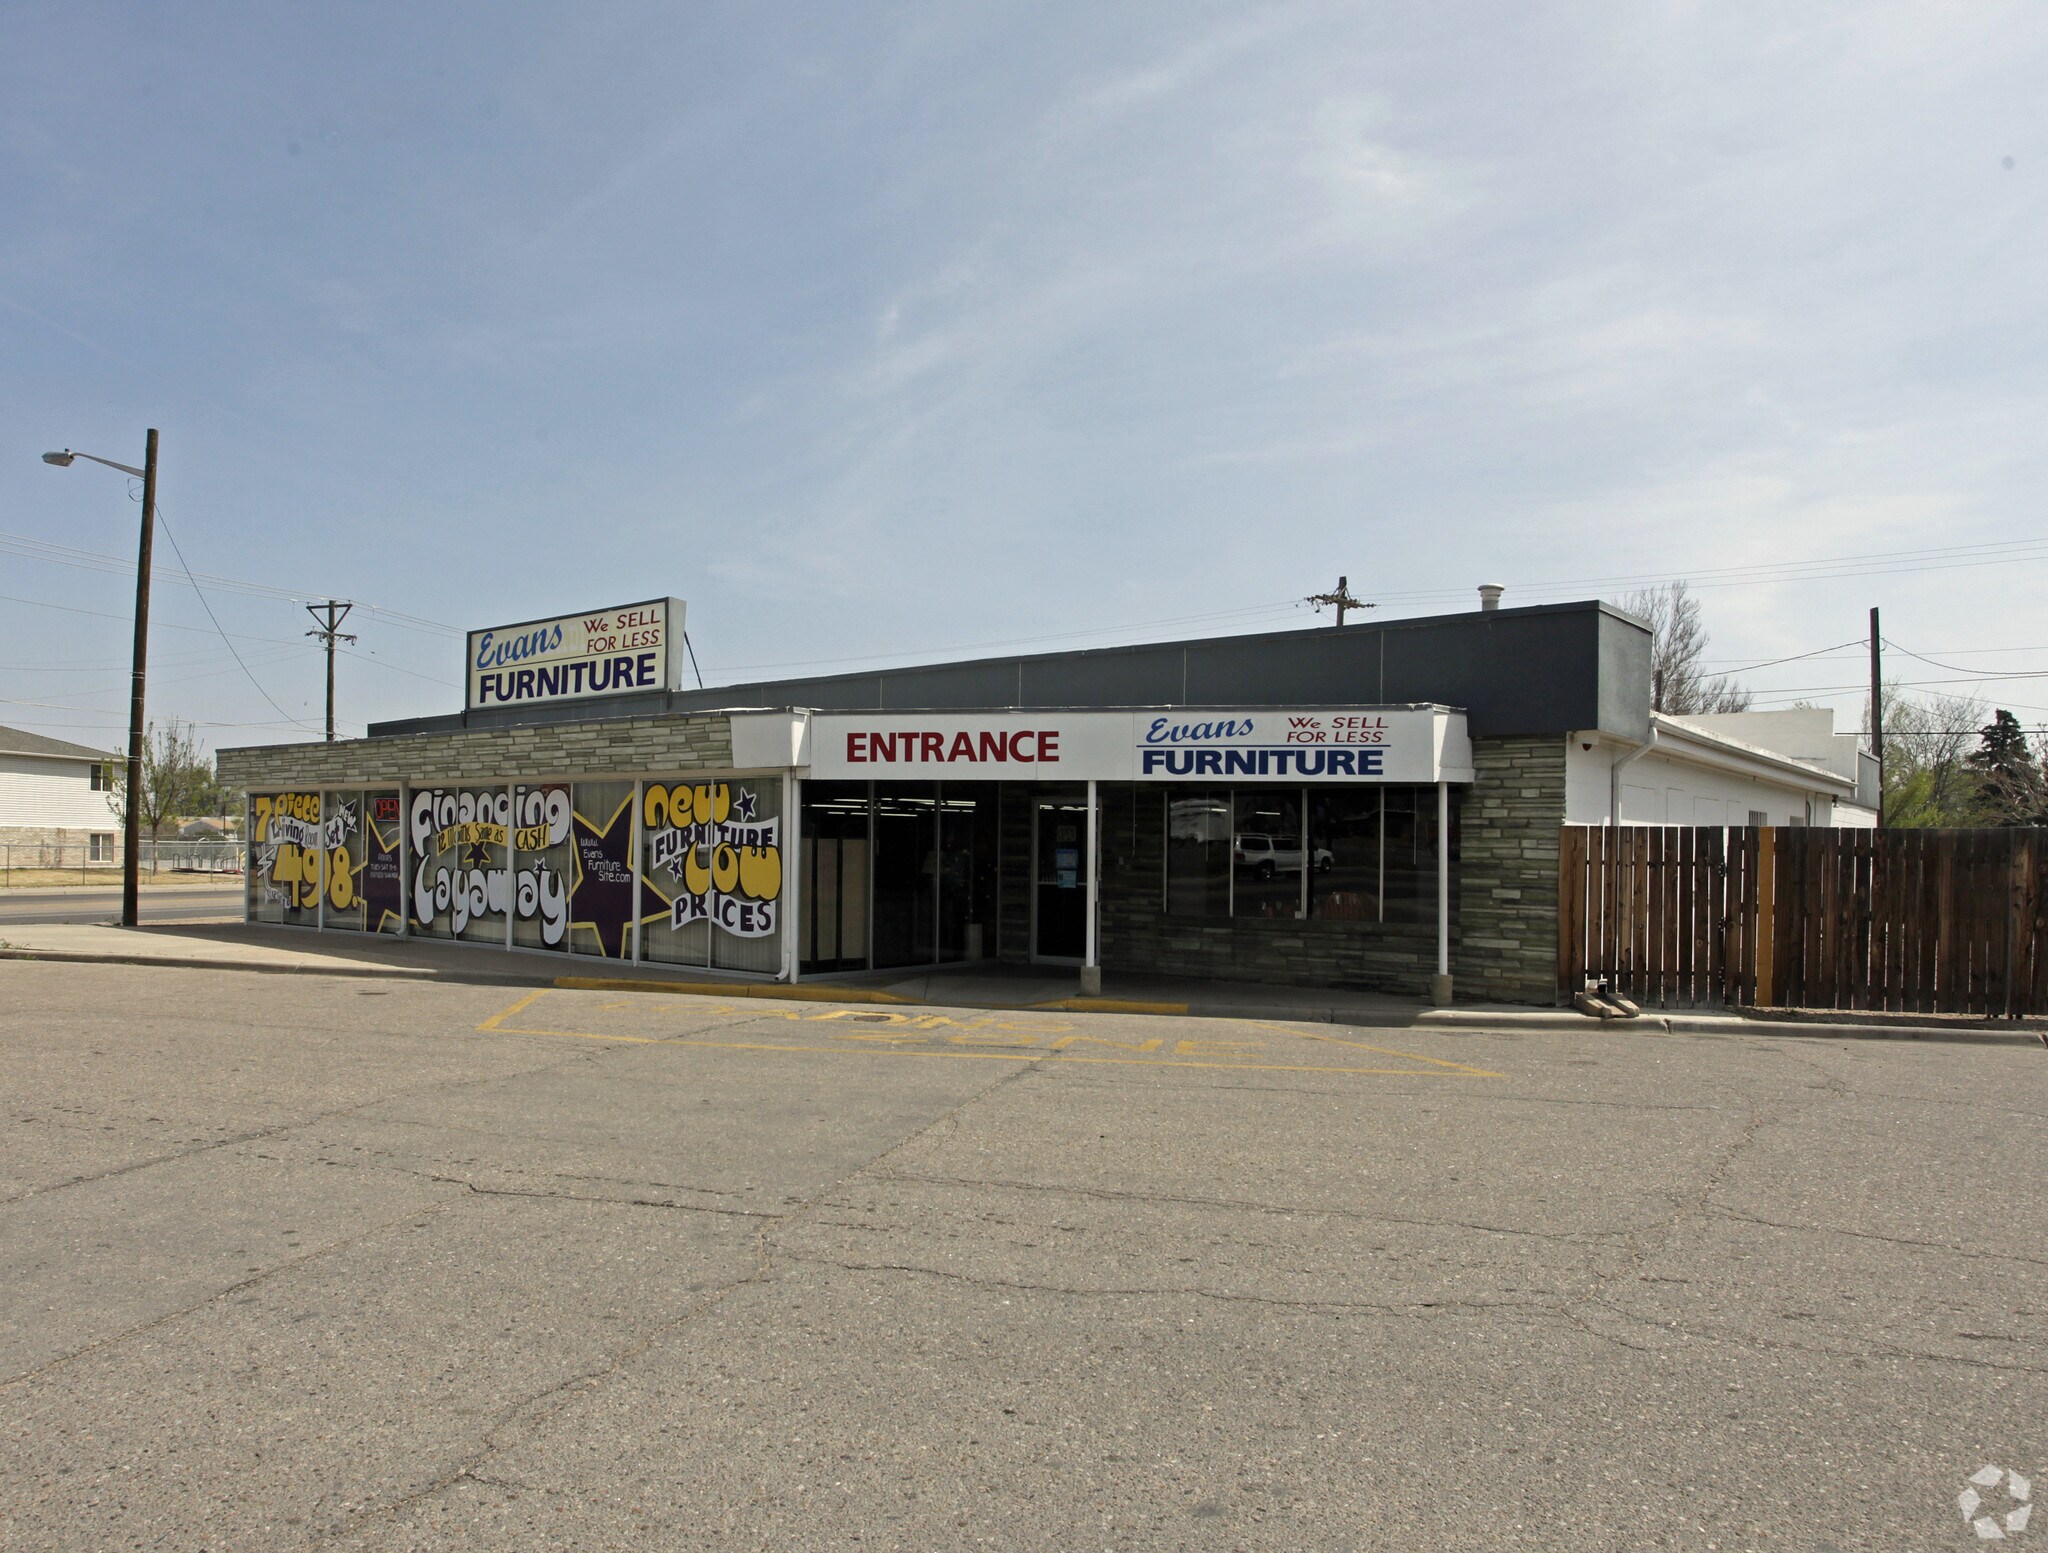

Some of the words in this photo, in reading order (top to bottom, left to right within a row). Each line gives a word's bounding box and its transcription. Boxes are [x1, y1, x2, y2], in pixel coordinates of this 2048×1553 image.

[583, 618, 609, 634] We
[616, 609, 661, 630] SELL
[476, 624, 563, 669] Evans
[587, 635, 617, 654] FOR
[622, 629, 660, 649] LESS
[479, 653, 656, 704] FURNITURE
[1145, 717, 1254, 744] Evans
[1286, 731, 1327, 743] FOR
[1334, 731, 1384, 743] LESS
[1288, 717, 1322, 729] We
[1331, 716, 1389, 729] SELL
[847, 730, 1060, 763] ENTRANCE
[1142, 749, 1384, 776] FURNITURE
[255, 797, 273, 842] 7
[325, 819, 341, 848] Set
[410, 786, 571, 858] Financing
[438, 832, 447, 853] 12
[515, 824, 547, 851] CASH
[656, 824, 773, 864] FURNITURE
[583, 849, 603, 859] Evans
[588, 859, 621, 871] Furniture
[598, 871, 631, 882] Site.com
[414, 854, 567, 946] Layaway
[675, 892, 772, 932] PRICES
[831, 1029, 1266, 1058] ZONE
